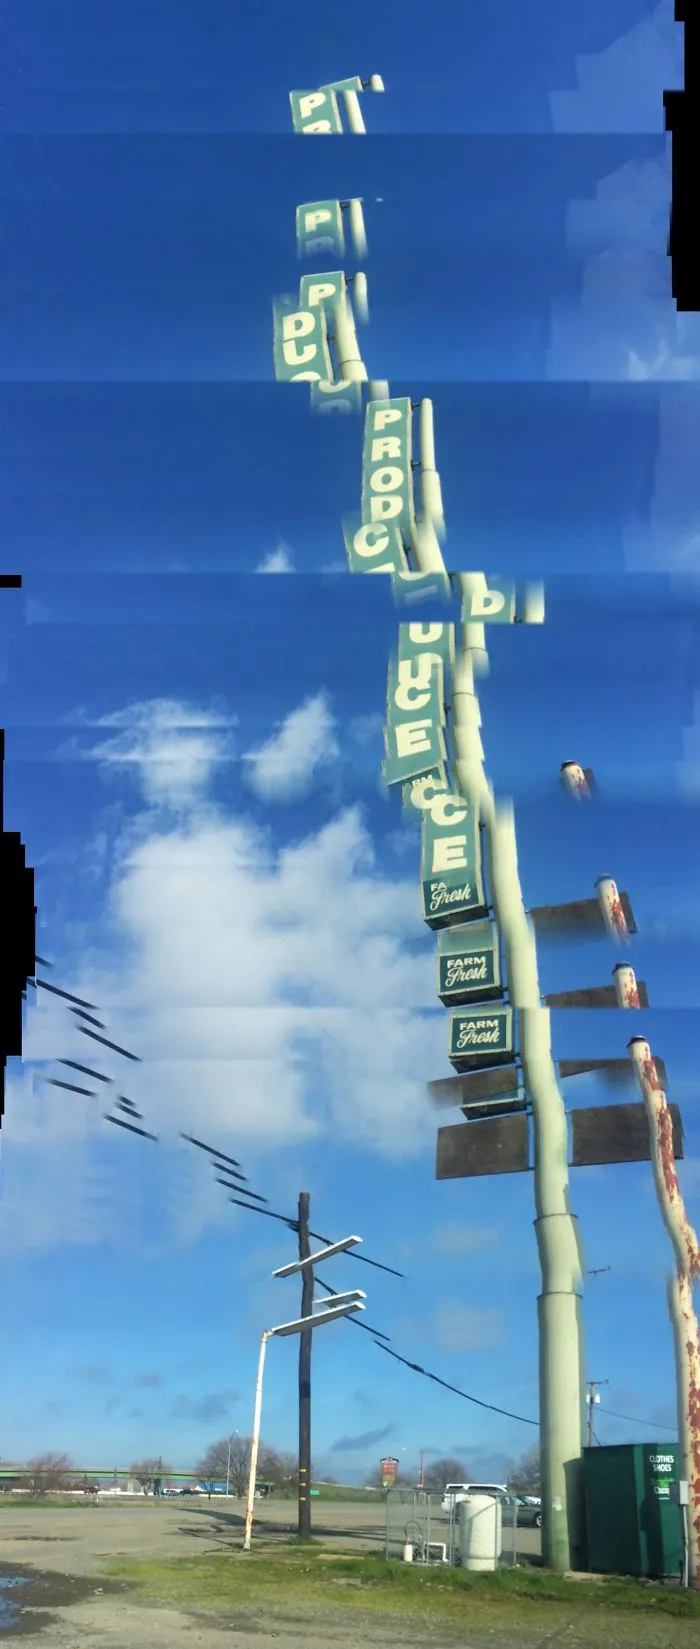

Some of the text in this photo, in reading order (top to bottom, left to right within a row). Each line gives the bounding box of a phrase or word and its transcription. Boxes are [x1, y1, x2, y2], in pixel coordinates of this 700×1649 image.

[429, 883, 472, 911] Fresh
[447, 956, 487, 969] FARM
[446, 964, 487, 987] Fresh
[459, 1019, 499, 1030] FARM
[456, 1027, 500, 1048] Fresh
[649, 1455, 675, 1463] CLOTHES
[653, 1464, 672, 1472] SHOES
